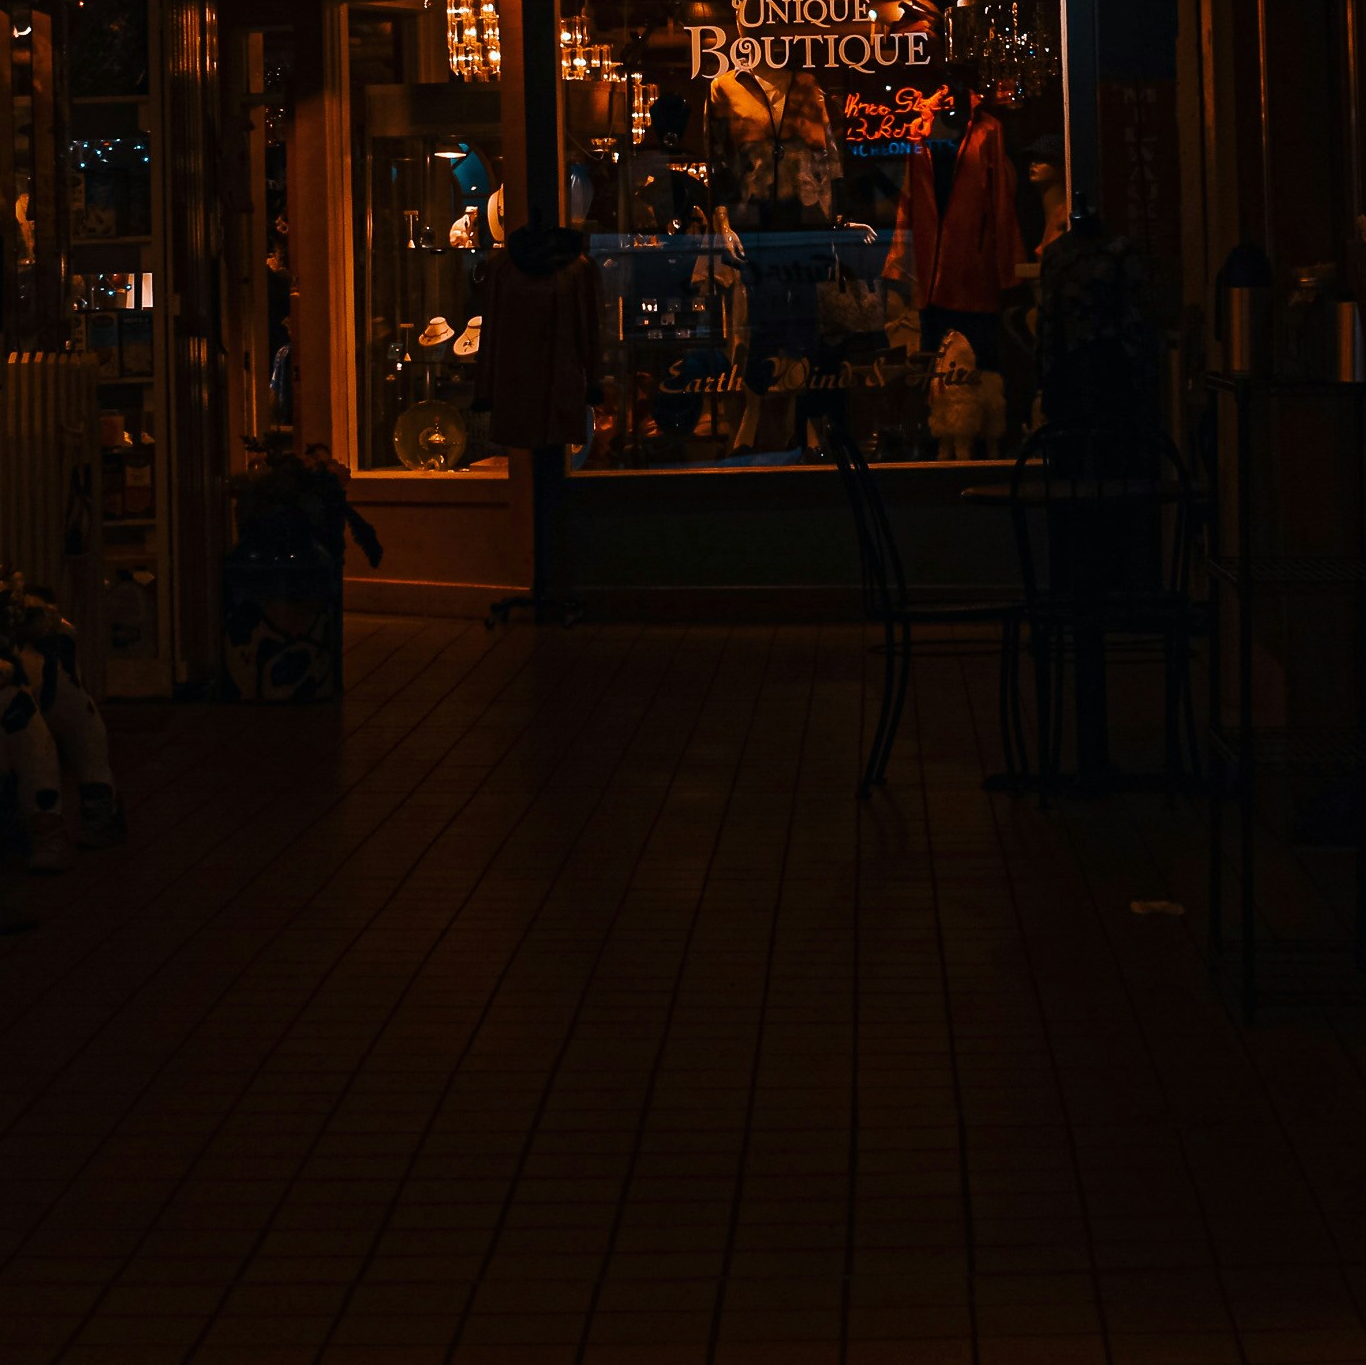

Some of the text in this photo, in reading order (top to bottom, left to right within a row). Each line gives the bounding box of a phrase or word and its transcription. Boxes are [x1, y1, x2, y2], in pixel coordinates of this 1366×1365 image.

[683, 25, 931, 80] BOUTIQUE
[659, 358, 744, 394] Earth
[763, 355, 853, 392] Wind
